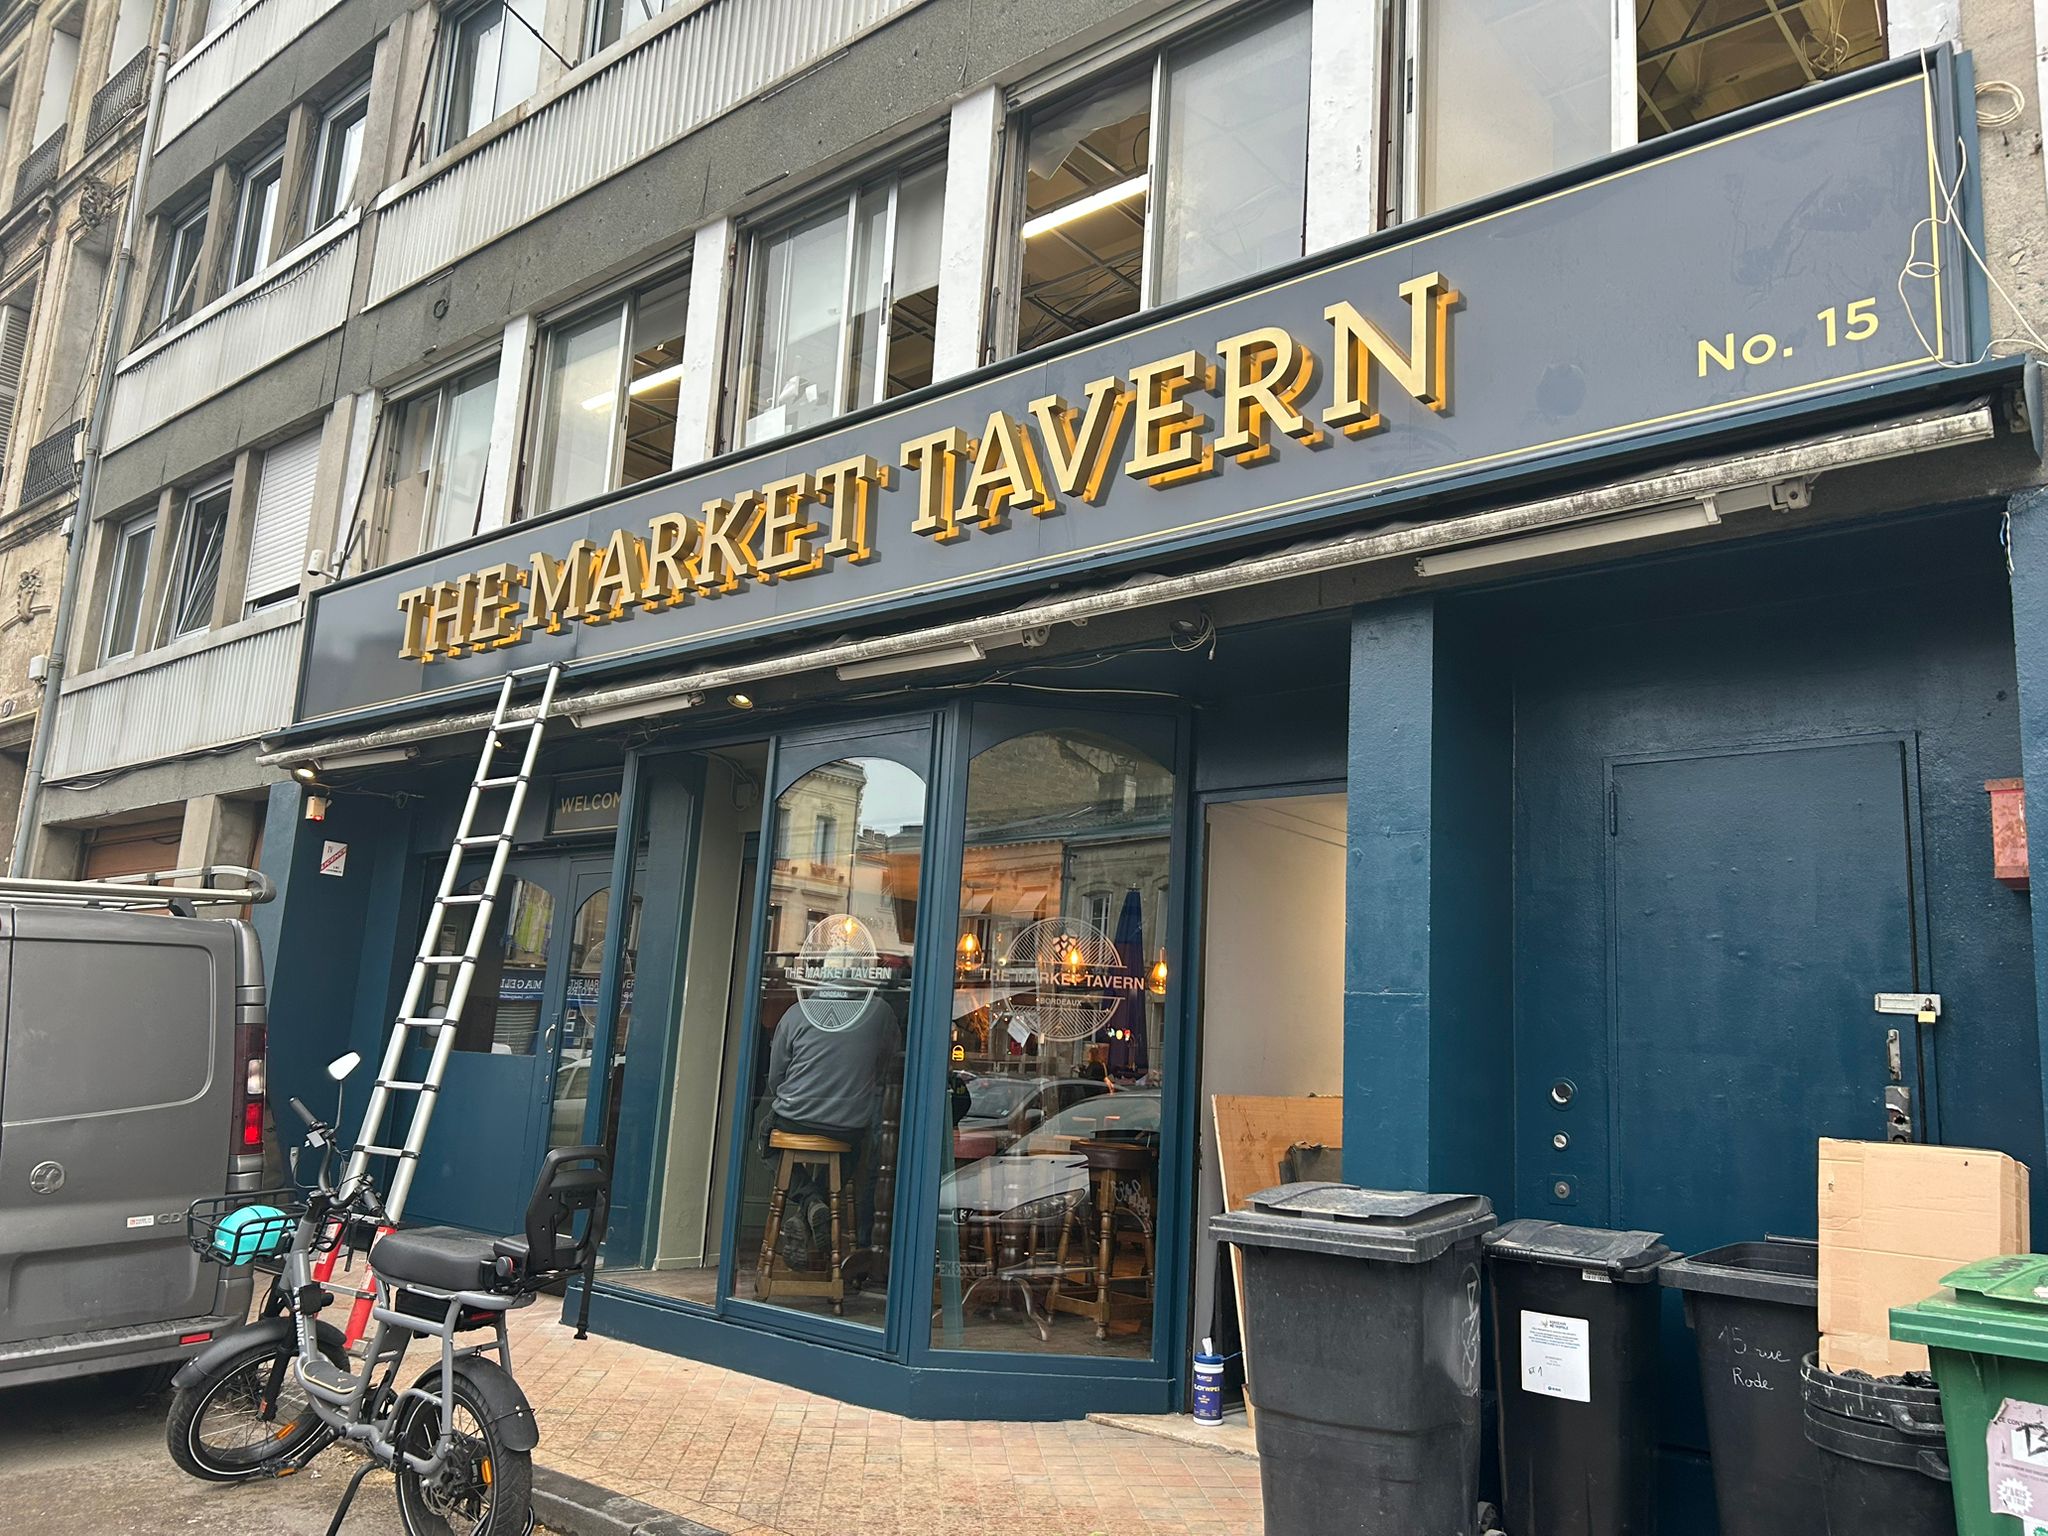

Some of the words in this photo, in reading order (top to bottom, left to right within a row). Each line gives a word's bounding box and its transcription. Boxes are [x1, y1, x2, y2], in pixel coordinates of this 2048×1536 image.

[1698, 332, 1793, 377] No.
[1816, 296, 1879, 347] 15
[398, 563, 517, 662] THE
[523, 454, 880, 631] MARKET
[900, 271, 1455, 537] TAVERN
[784, 966, 804, 979] THE
[805, 966, 848, 979] MARKET
[850, 967, 893, 980] TAVERN
[980, 967, 1011, 982] THE
[1014, 970, 1082, 987] MARKET
[1084, 973, 1145, 991] TAVERN
[1039, 996, 1083, 1008] BORDEAUX
[1718, 1324, 1747, 1354] 15
[1756, 1348, 1792, 1363] rue
[1732, 1366, 1775, 1391] Rode
